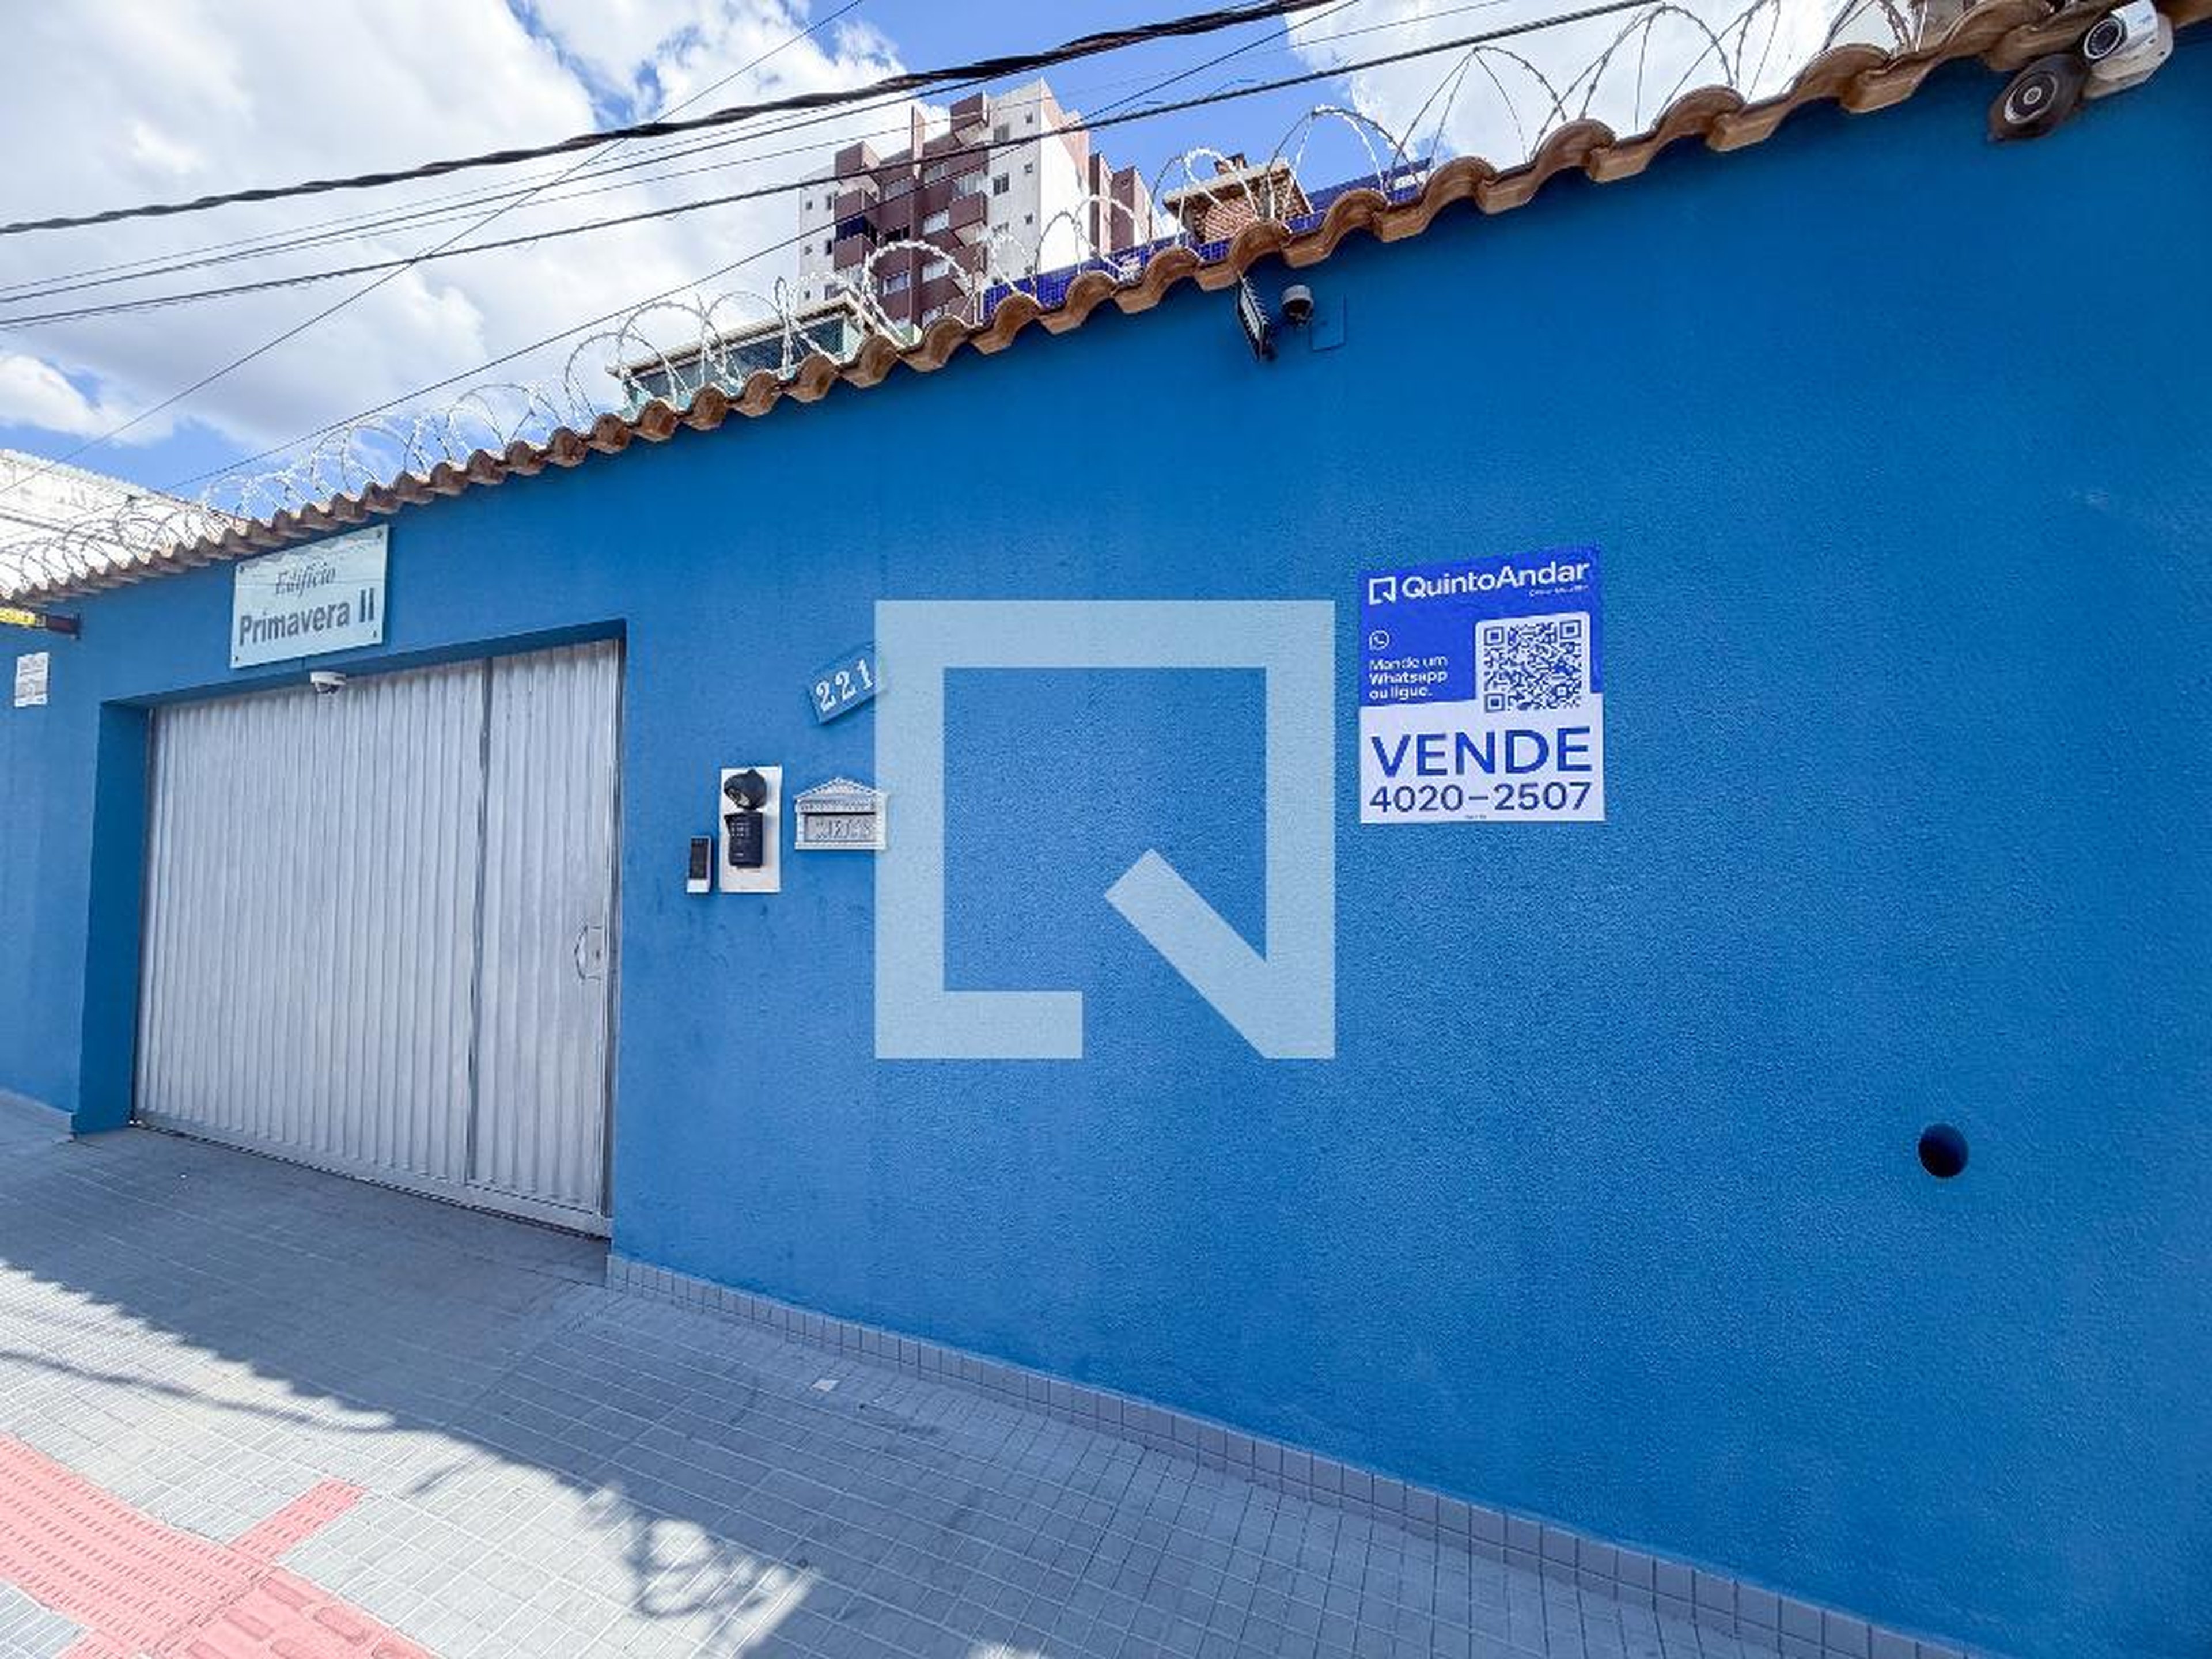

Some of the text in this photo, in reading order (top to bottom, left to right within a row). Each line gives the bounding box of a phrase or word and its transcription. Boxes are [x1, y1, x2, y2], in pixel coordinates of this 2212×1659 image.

[1401, 561, 1590, 599] QuintoAndar
[238, 600, 350, 646] Primavera
[1369, 656, 1420, 671] Mande
[816, 658, 873, 712] 221
[1369, 685, 1433, 701] ou ligue.
[1370, 726, 1593, 778] VENDE
